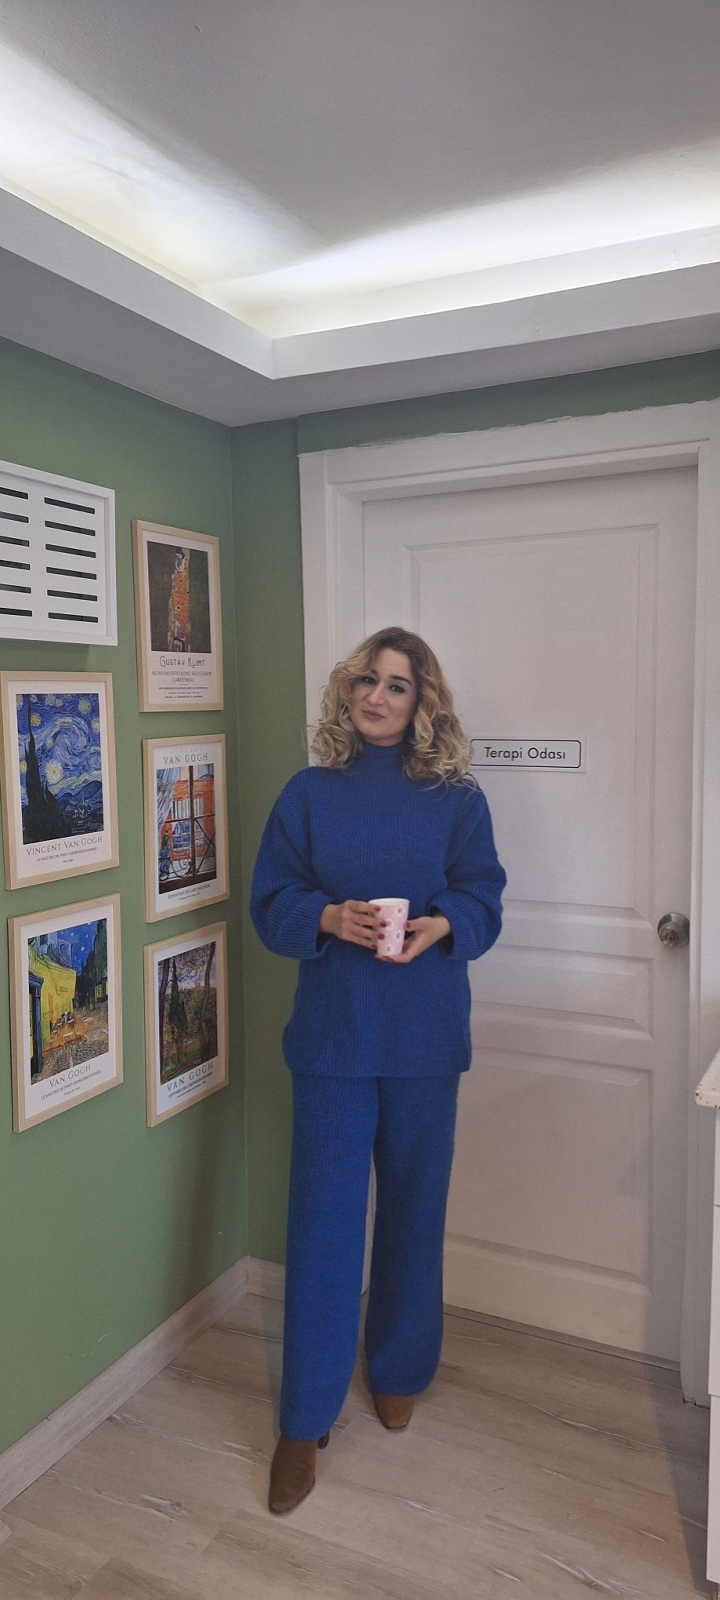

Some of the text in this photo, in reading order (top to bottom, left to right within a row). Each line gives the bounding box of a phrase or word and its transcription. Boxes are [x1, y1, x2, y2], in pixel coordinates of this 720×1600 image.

[159, 655, 206, 669] GUSTAV KLIMT
[163, 752, 208, 765] VAN GOGH
[484, 746, 566, 761] Terapi Odası
[26, 835, 103, 856] VINCENT VAN GOGH
[49, 1063, 92, 1088] VAN GOGH
[166, 1076, 186, 1092] VAN
[188, 1061, 214, 1081] GOGH
